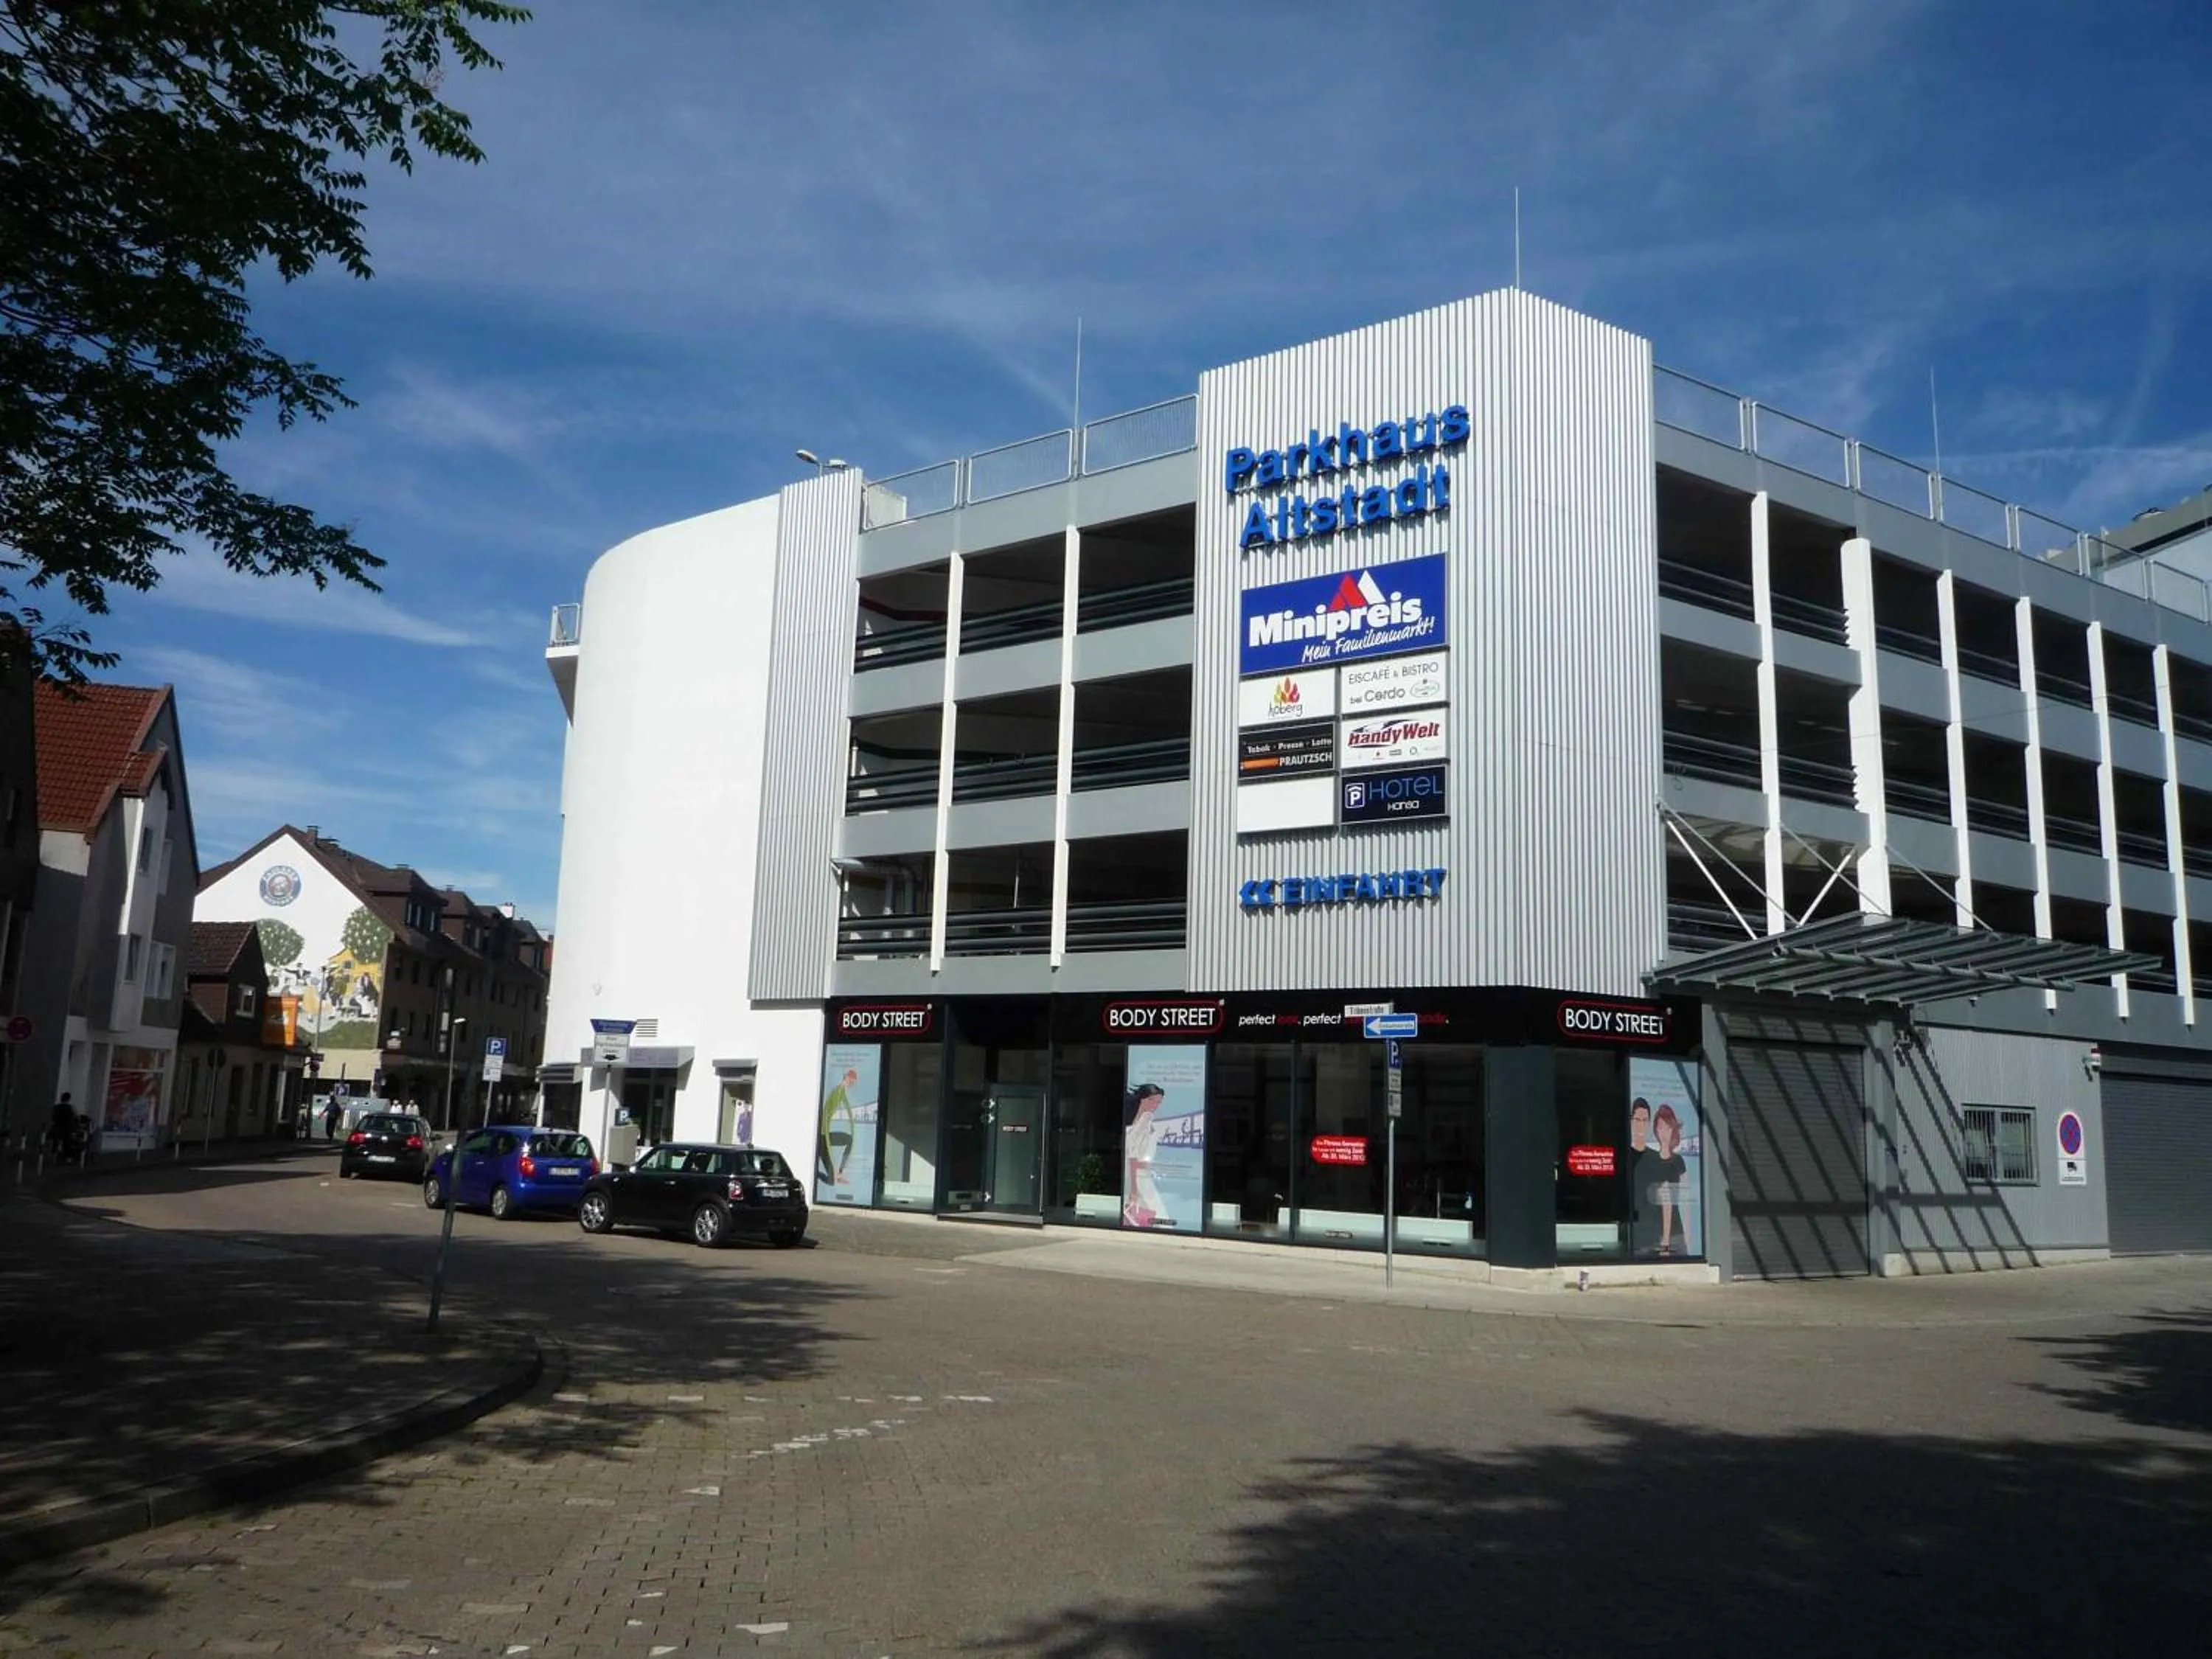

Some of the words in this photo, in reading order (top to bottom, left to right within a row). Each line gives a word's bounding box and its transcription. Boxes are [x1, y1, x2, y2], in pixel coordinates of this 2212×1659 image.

[1226, 405, 1470, 493] Parkhaus
[1240, 465, 1450, 548] Altstadt
[1249, 591, 1422, 647] Minipreis
[1302, 641, 1330, 663] Mein
[1335, 616, 1435, 655] Familienmarkt!
[1349, 666, 1390, 684] EISCAFÉ
[1402, 662, 1439, 677] BISTRO
[1348, 723, 1440, 746] HandyWelt
[1279, 752, 1332, 767] PRAUTZSCH
[1282, 868, 1447, 905] EINFAHRT
[843, 1012, 883, 1029] BODY
[882, 1011, 925, 1028] STREET
[1110, 1009, 1158, 1026] BODY
[1160, 1007, 1216, 1026] STREET
[1239, 1014, 1276, 1026] perfect
[1303, 1012, 1341, 1026] perfect
[1565, 1007, 1611, 1031] BODY
[1615, 1012, 1664, 1035] STREET
